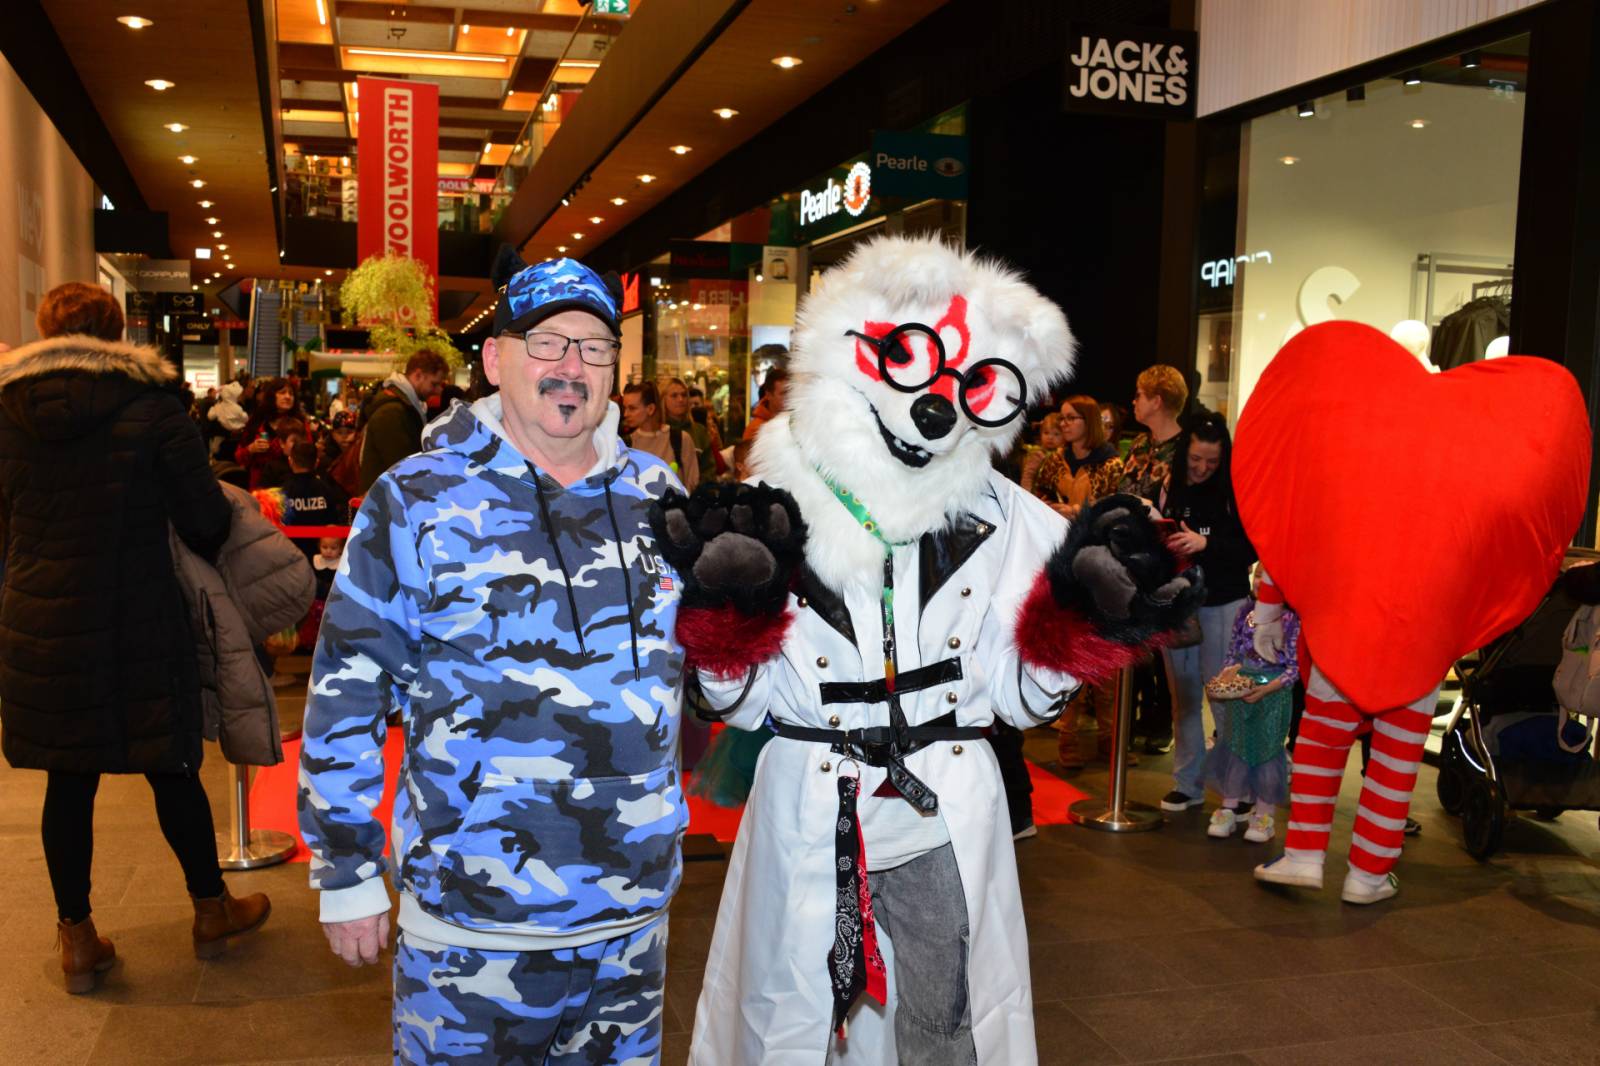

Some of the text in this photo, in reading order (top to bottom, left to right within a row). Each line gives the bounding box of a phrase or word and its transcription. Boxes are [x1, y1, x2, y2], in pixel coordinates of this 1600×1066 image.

[1070, 36, 1189, 76] JACK&
[1069, 67, 1188, 106] JONES
[876, 152, 928, 172] Pearle
[800, 177, 841, 227] Pearle
[186, 322, 211, 331] ONLY
[640, 552, 672, 575] US
